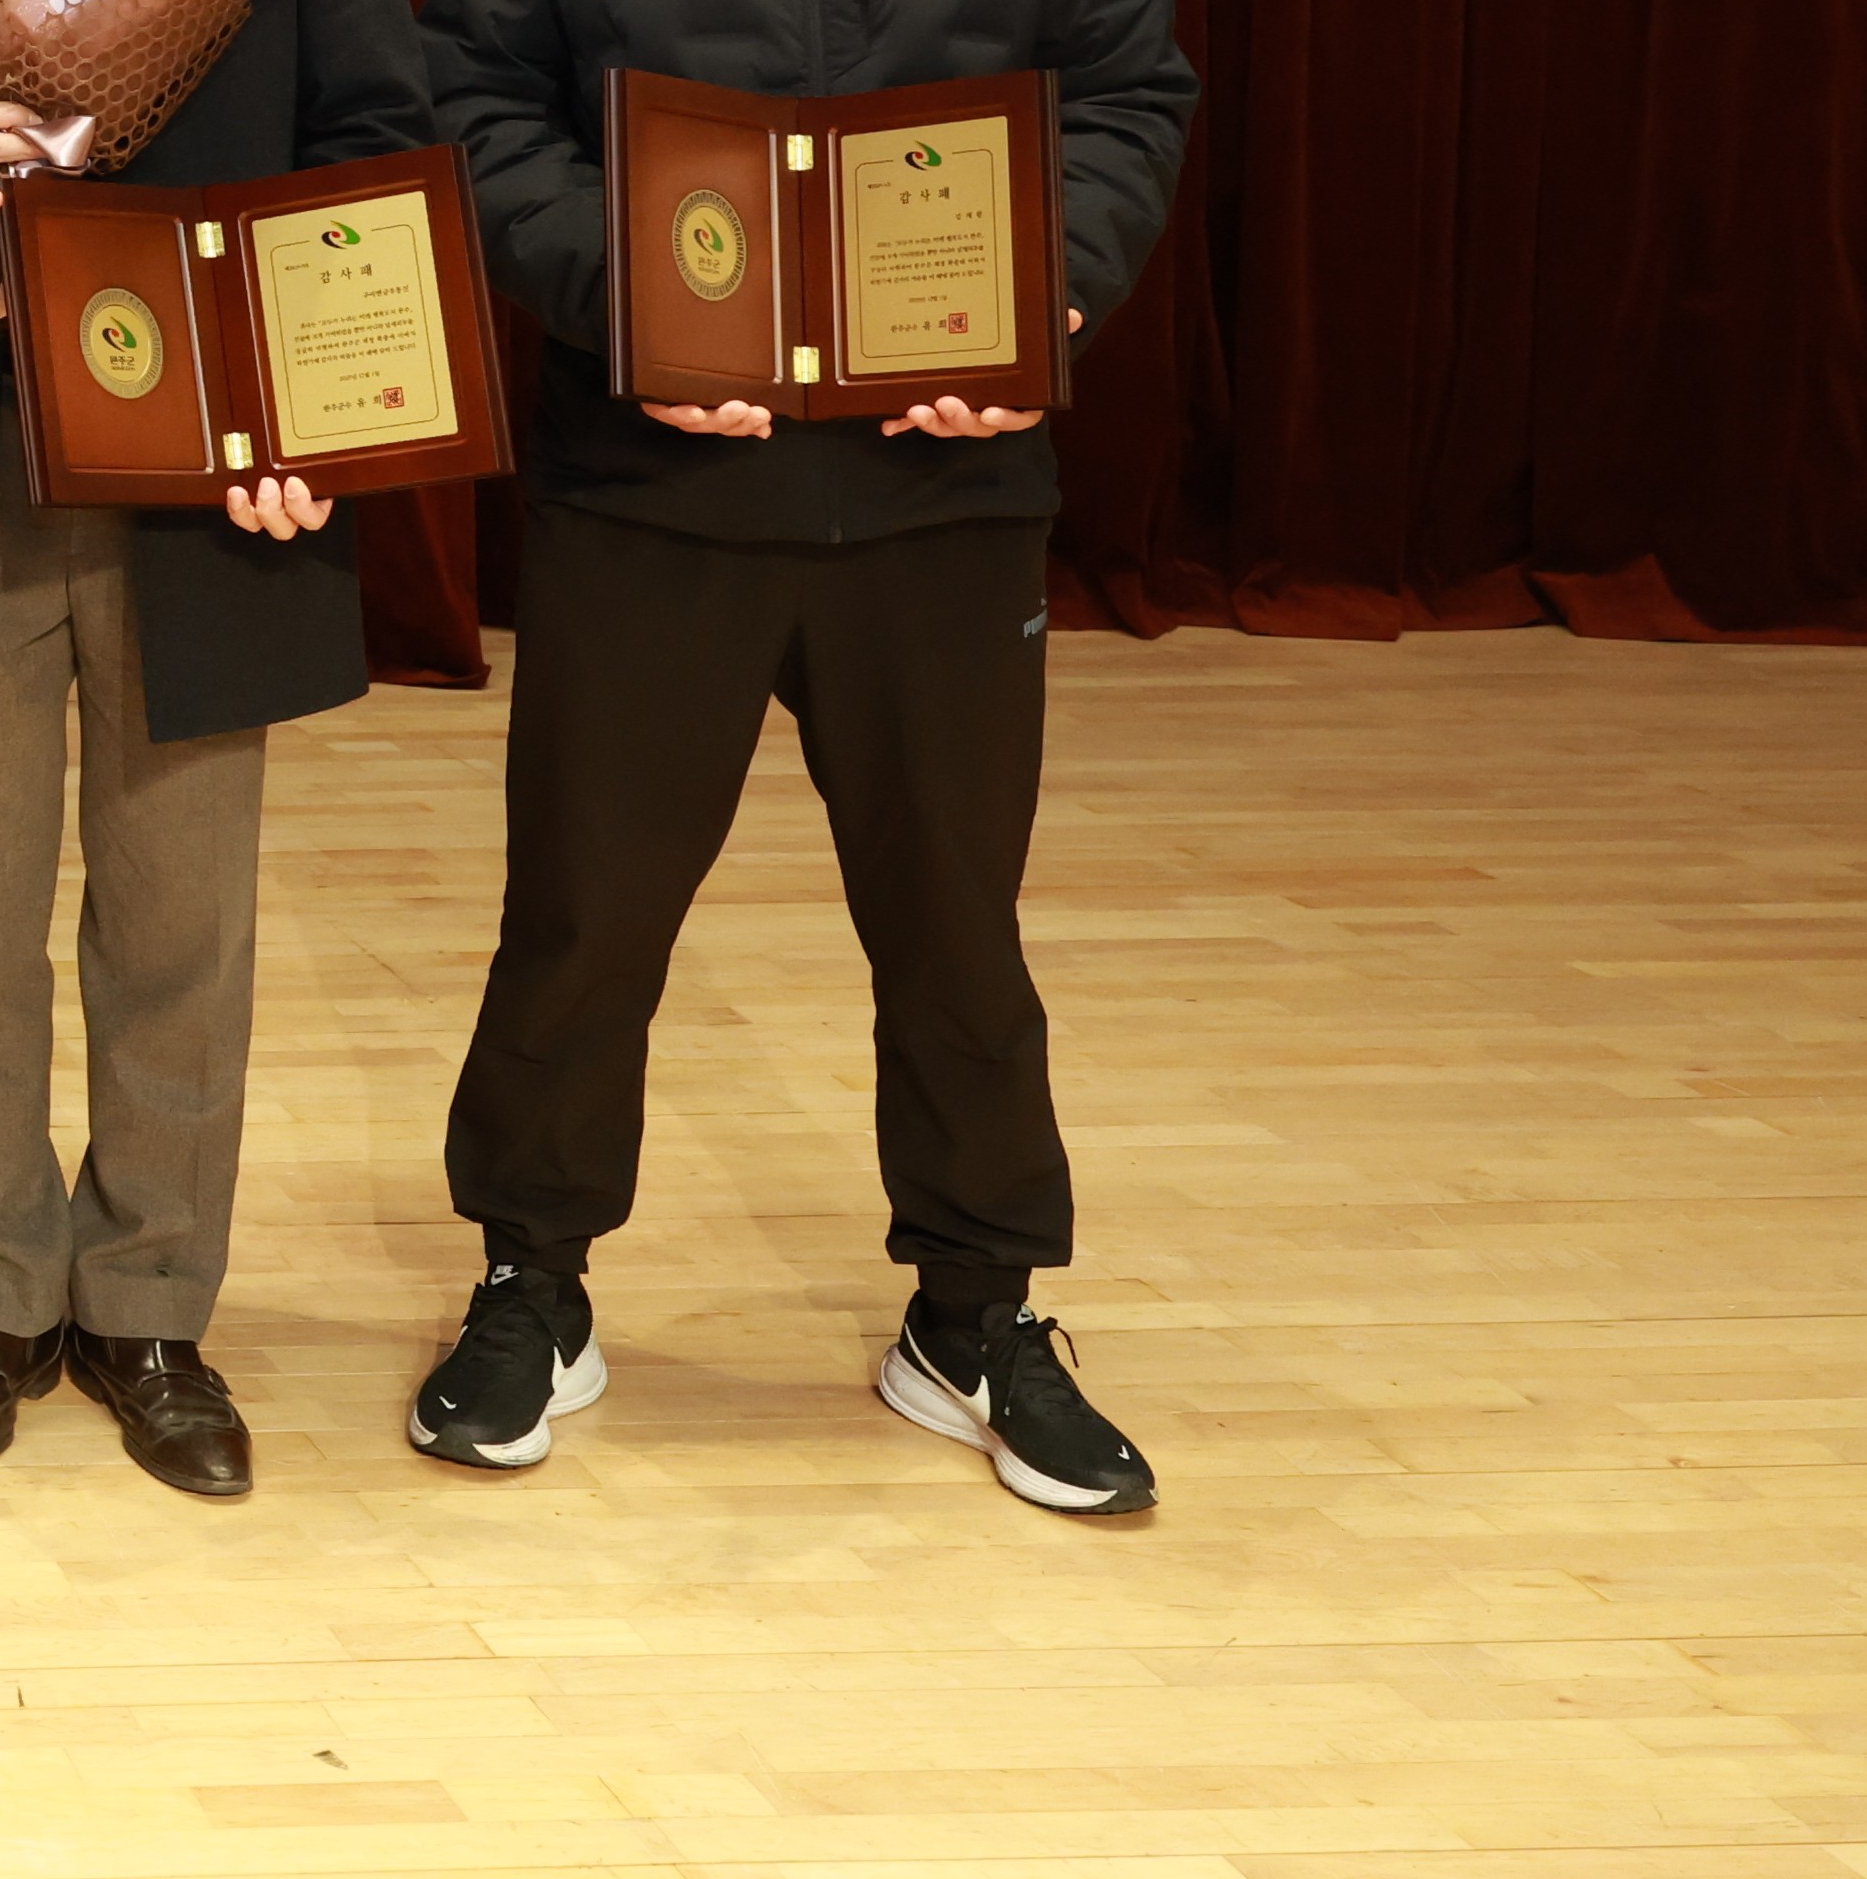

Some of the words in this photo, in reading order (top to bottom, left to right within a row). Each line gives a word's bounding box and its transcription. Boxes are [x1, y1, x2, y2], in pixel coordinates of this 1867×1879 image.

[899, 190, 911, 205] 감
[921, 188, 930, 203] 사
[320, 270, 331, 284] 감
[341, 267, 352, 281] 사
[361, 263, 372, 277] 패
[109, 355, 135, 366] 완주군
